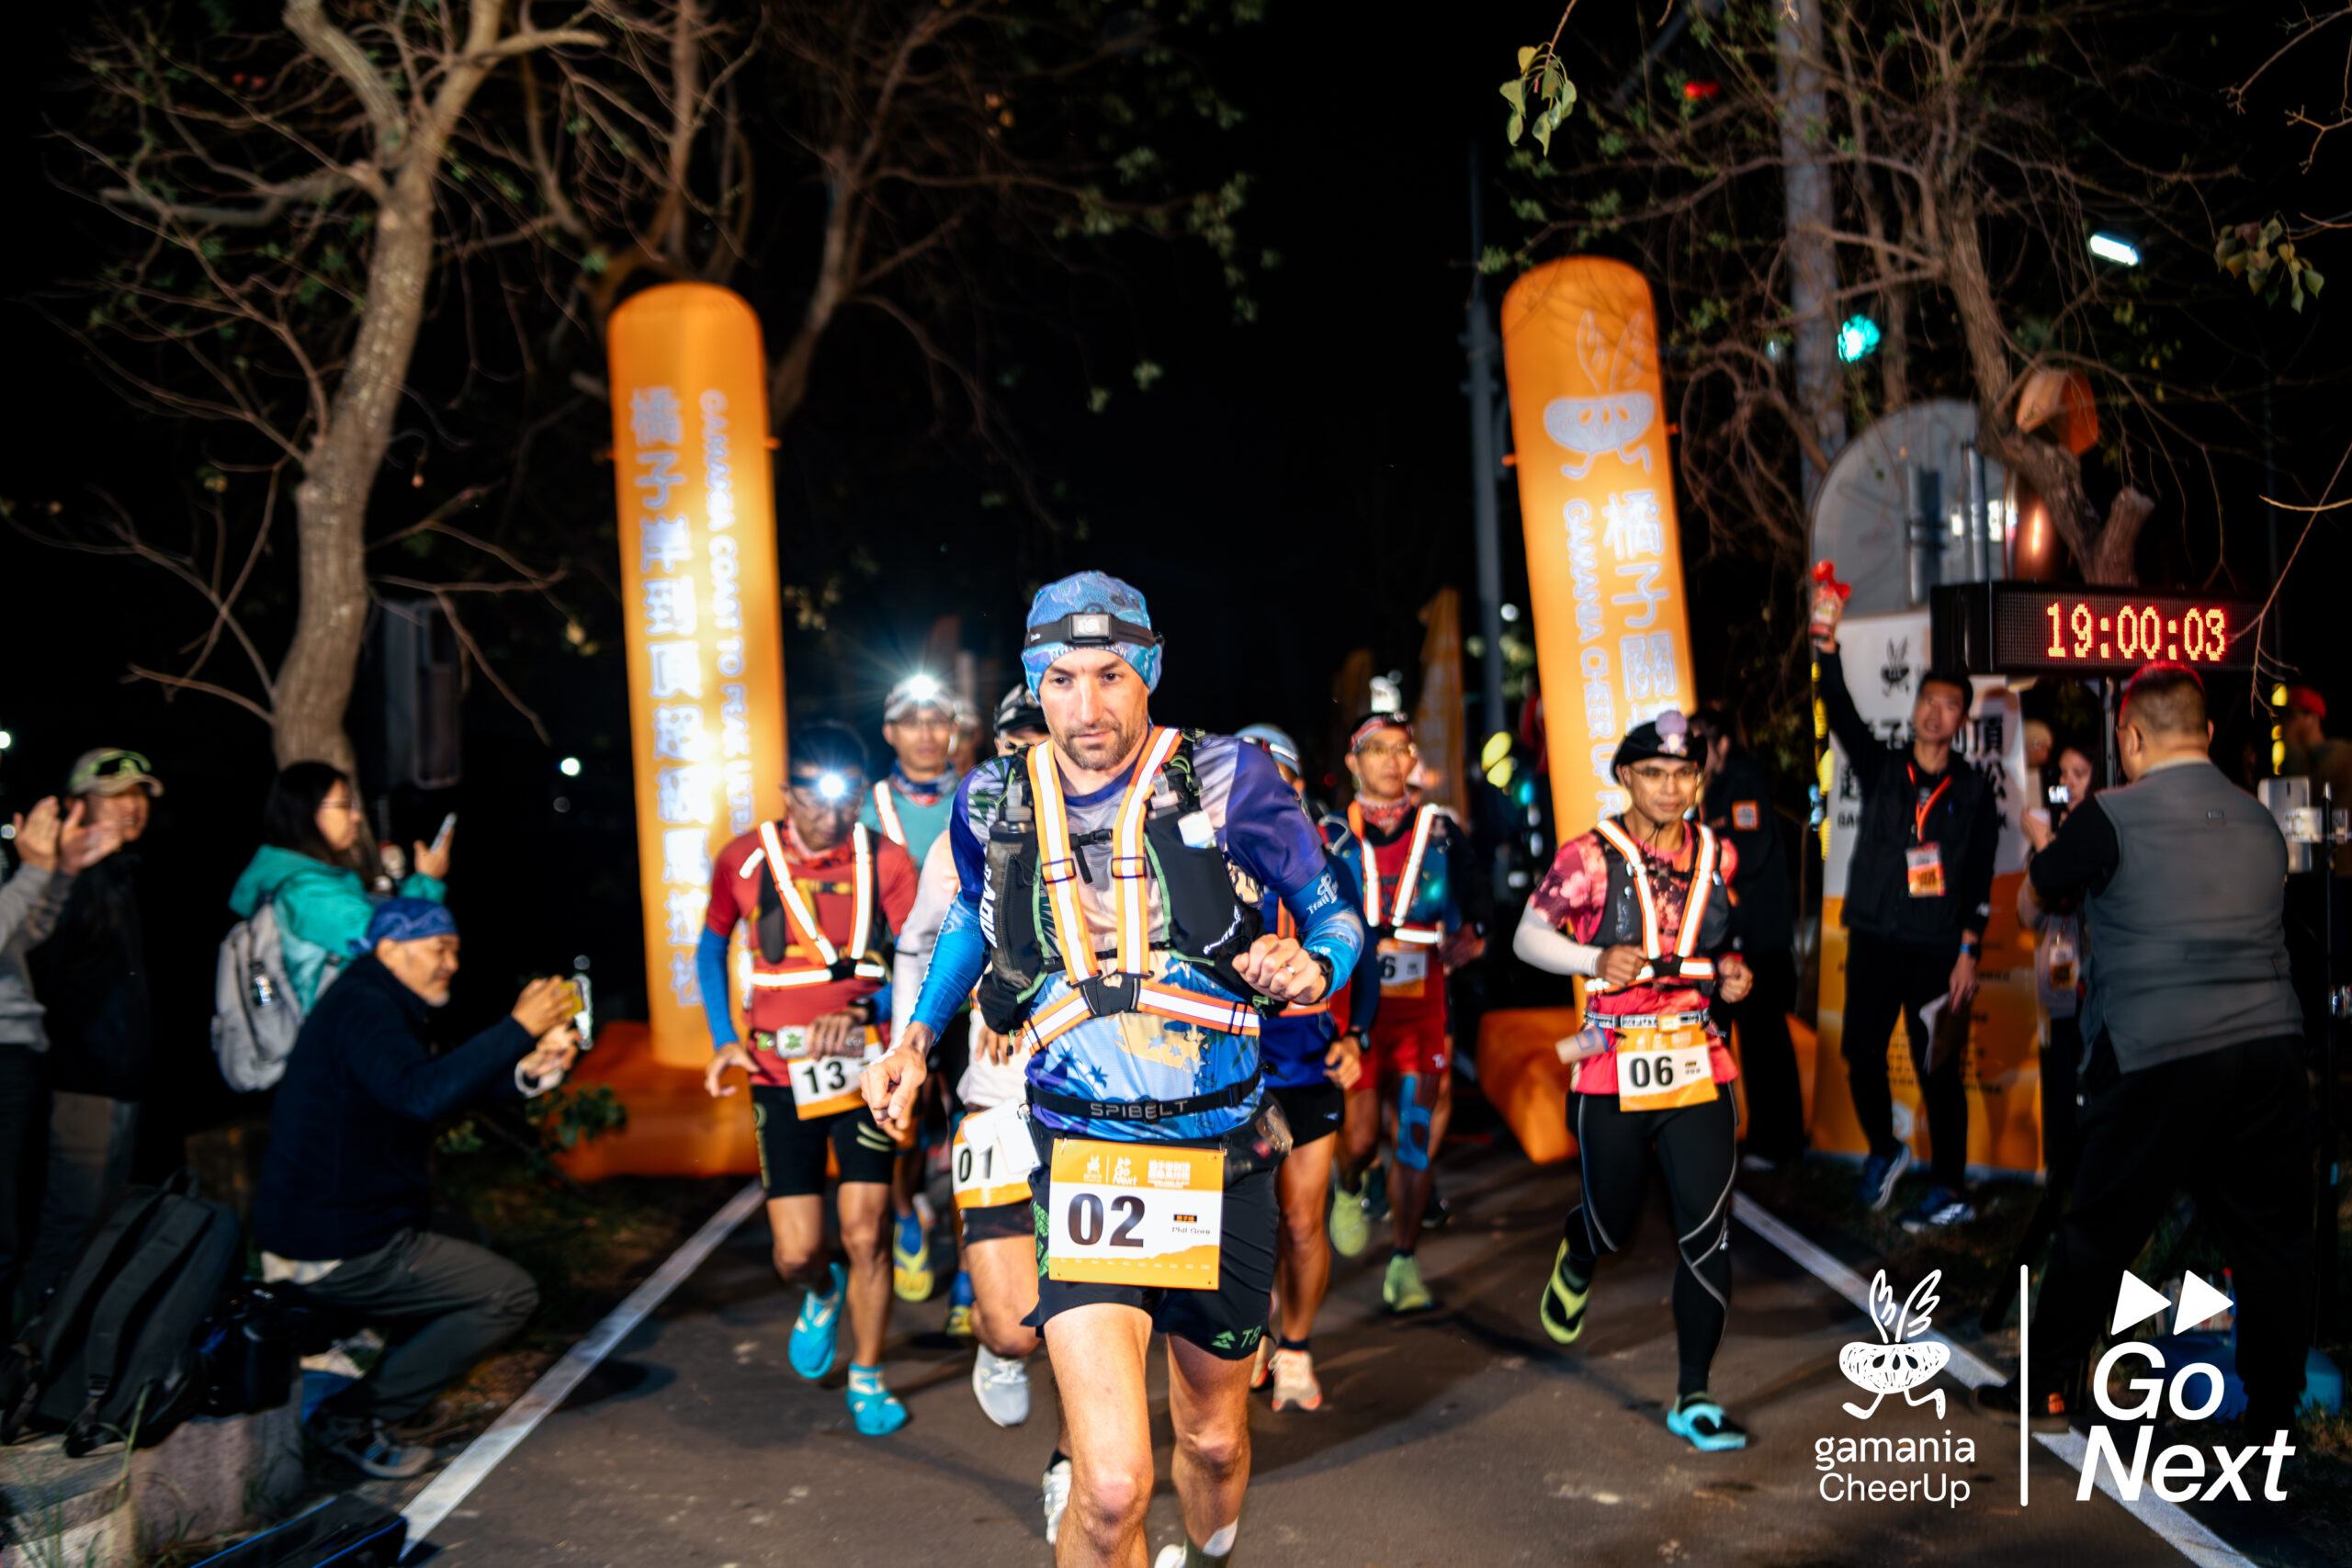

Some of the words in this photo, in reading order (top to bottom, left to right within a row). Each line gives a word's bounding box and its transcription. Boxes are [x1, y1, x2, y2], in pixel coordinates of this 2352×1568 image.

[1564, 500, 1603, 642] GAMANIA
[2047, 602, 2227, 661] 19:00:03
[716, 638, 745, 677] TO
[1580, 647, 1616, 739] CHEER
[802, 1060, 847, 1095] 13
[1629, 1056, 1674, 1088] 06
[1090, 1100, 1190, 1120] SPIBELT
[958, 1147, 993, 1184] 01
[1068, 1192, 1146, 1248] 02
